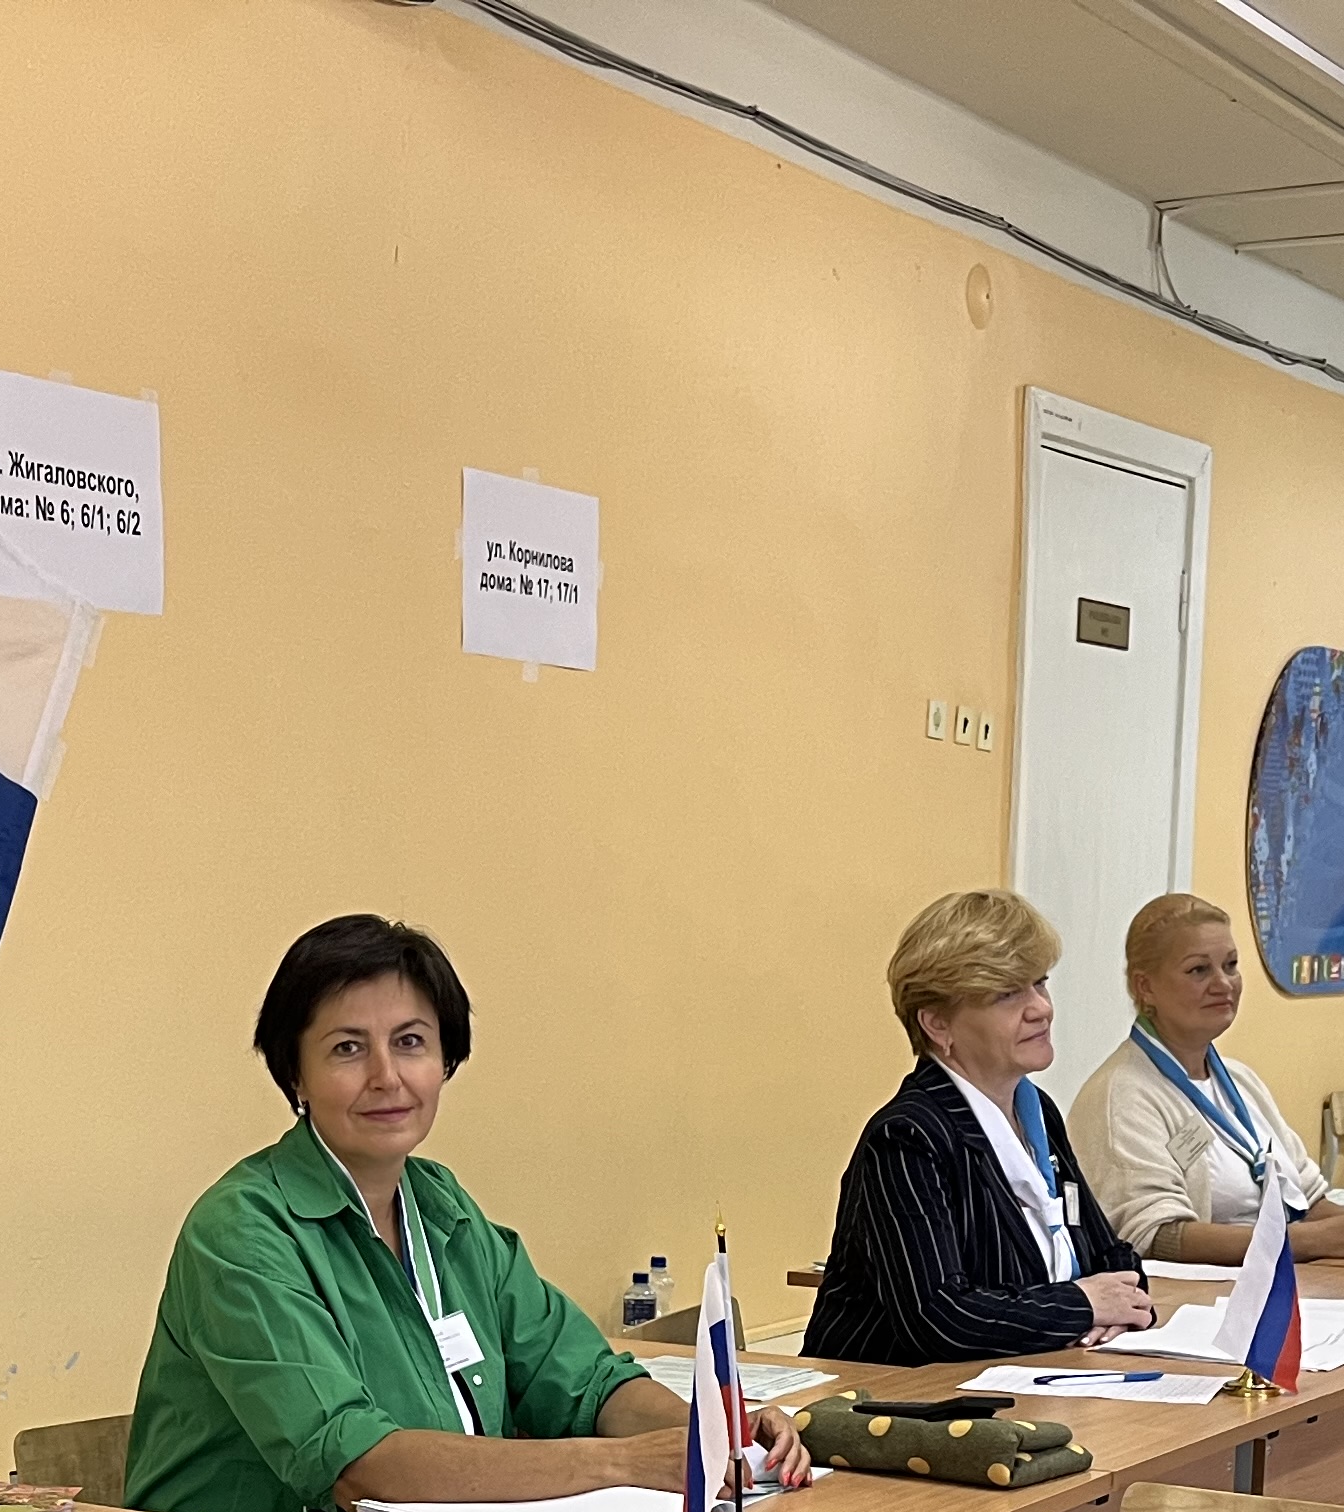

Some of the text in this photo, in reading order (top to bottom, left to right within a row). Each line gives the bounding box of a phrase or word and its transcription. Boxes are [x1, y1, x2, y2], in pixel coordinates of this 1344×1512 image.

[8, 450, 140, 504] Жигаловского,
[35, 494, 55, 522] №
[60, 499, 75, 531] 6;
[80, 503, 111, 536] 6/1;
[116, 509, 142, 536] 6/2
[486, 540, 574, 573] ул. Корнилова
[479, 572, 516, 593] дома:
[519, 573, 534, 596] №
[556, 581, 578, 605] 17/1
